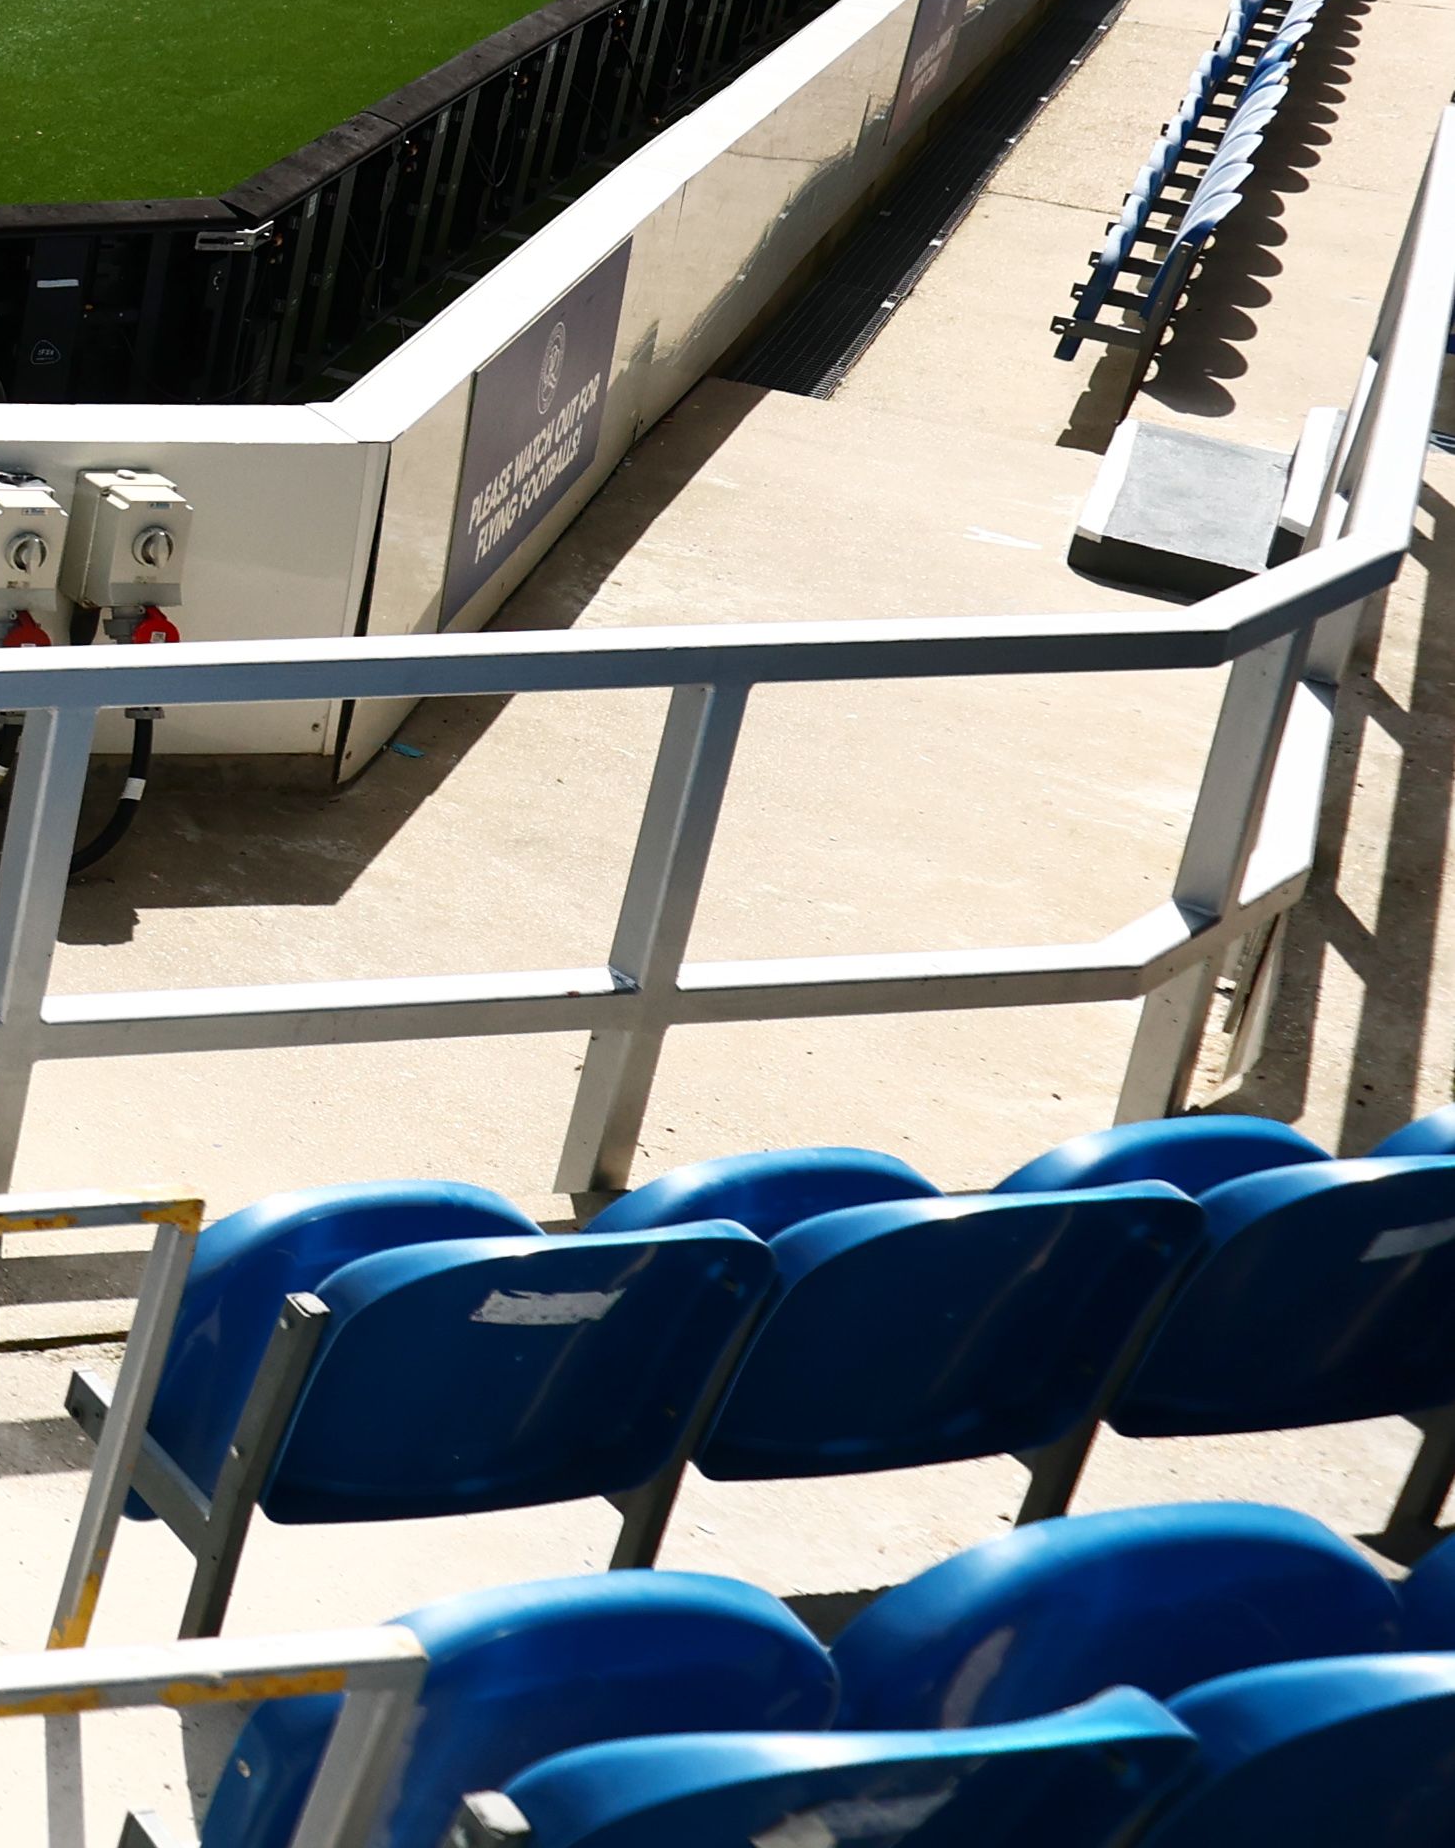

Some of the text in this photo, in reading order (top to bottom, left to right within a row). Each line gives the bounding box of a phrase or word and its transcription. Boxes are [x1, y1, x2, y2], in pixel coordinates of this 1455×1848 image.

[468, 372, 601, 535] PLEASE WATCH OUT FOR
[474, 424, 584, 565] FLYING FOOTBALLS!
